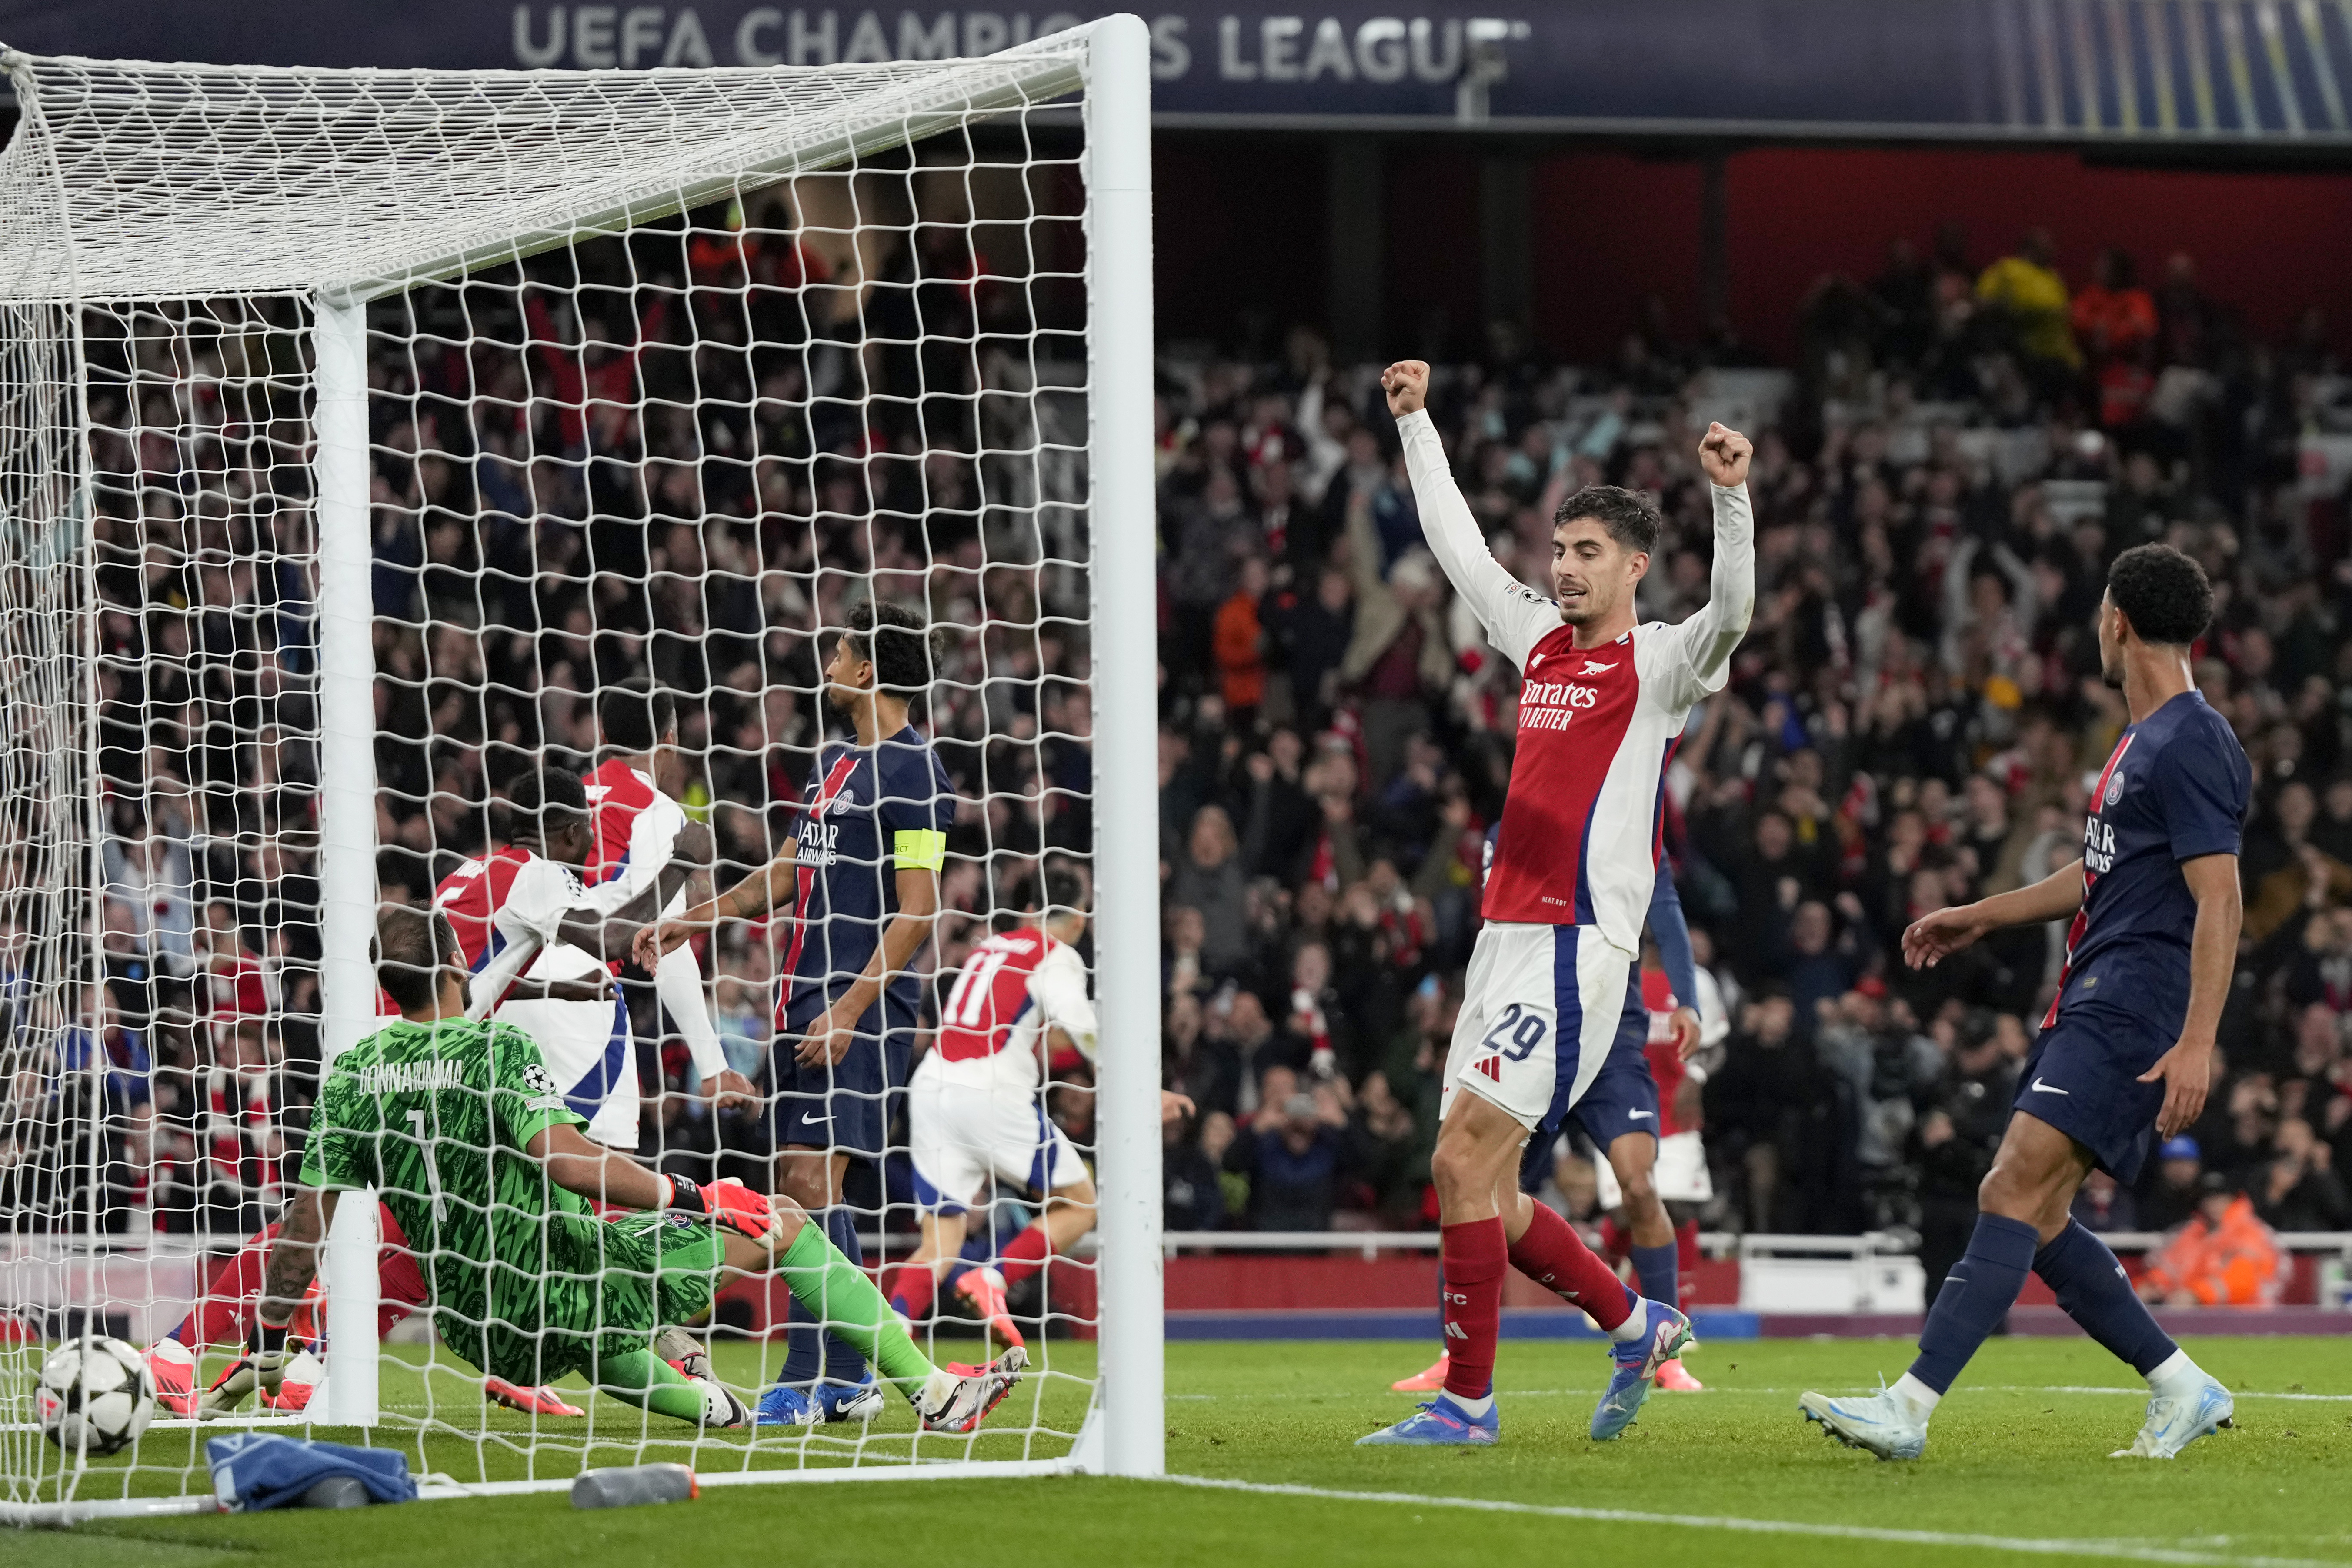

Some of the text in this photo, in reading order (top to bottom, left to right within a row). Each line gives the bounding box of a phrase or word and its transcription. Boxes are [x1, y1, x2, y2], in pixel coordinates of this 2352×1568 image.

[513, 6, 714, 69] UEFA
[735, 6, 1191, 81] CHAMPIS
[1527, 707, 1573, 731] BETTER
[1542, 896, 1567, 907] HEAT.RDY
[1480, 1003, 1548, 1063] 29
[359, 1059, 462, 1096] DONNARUMMA
[406, 1109, 447, 1222] 1
